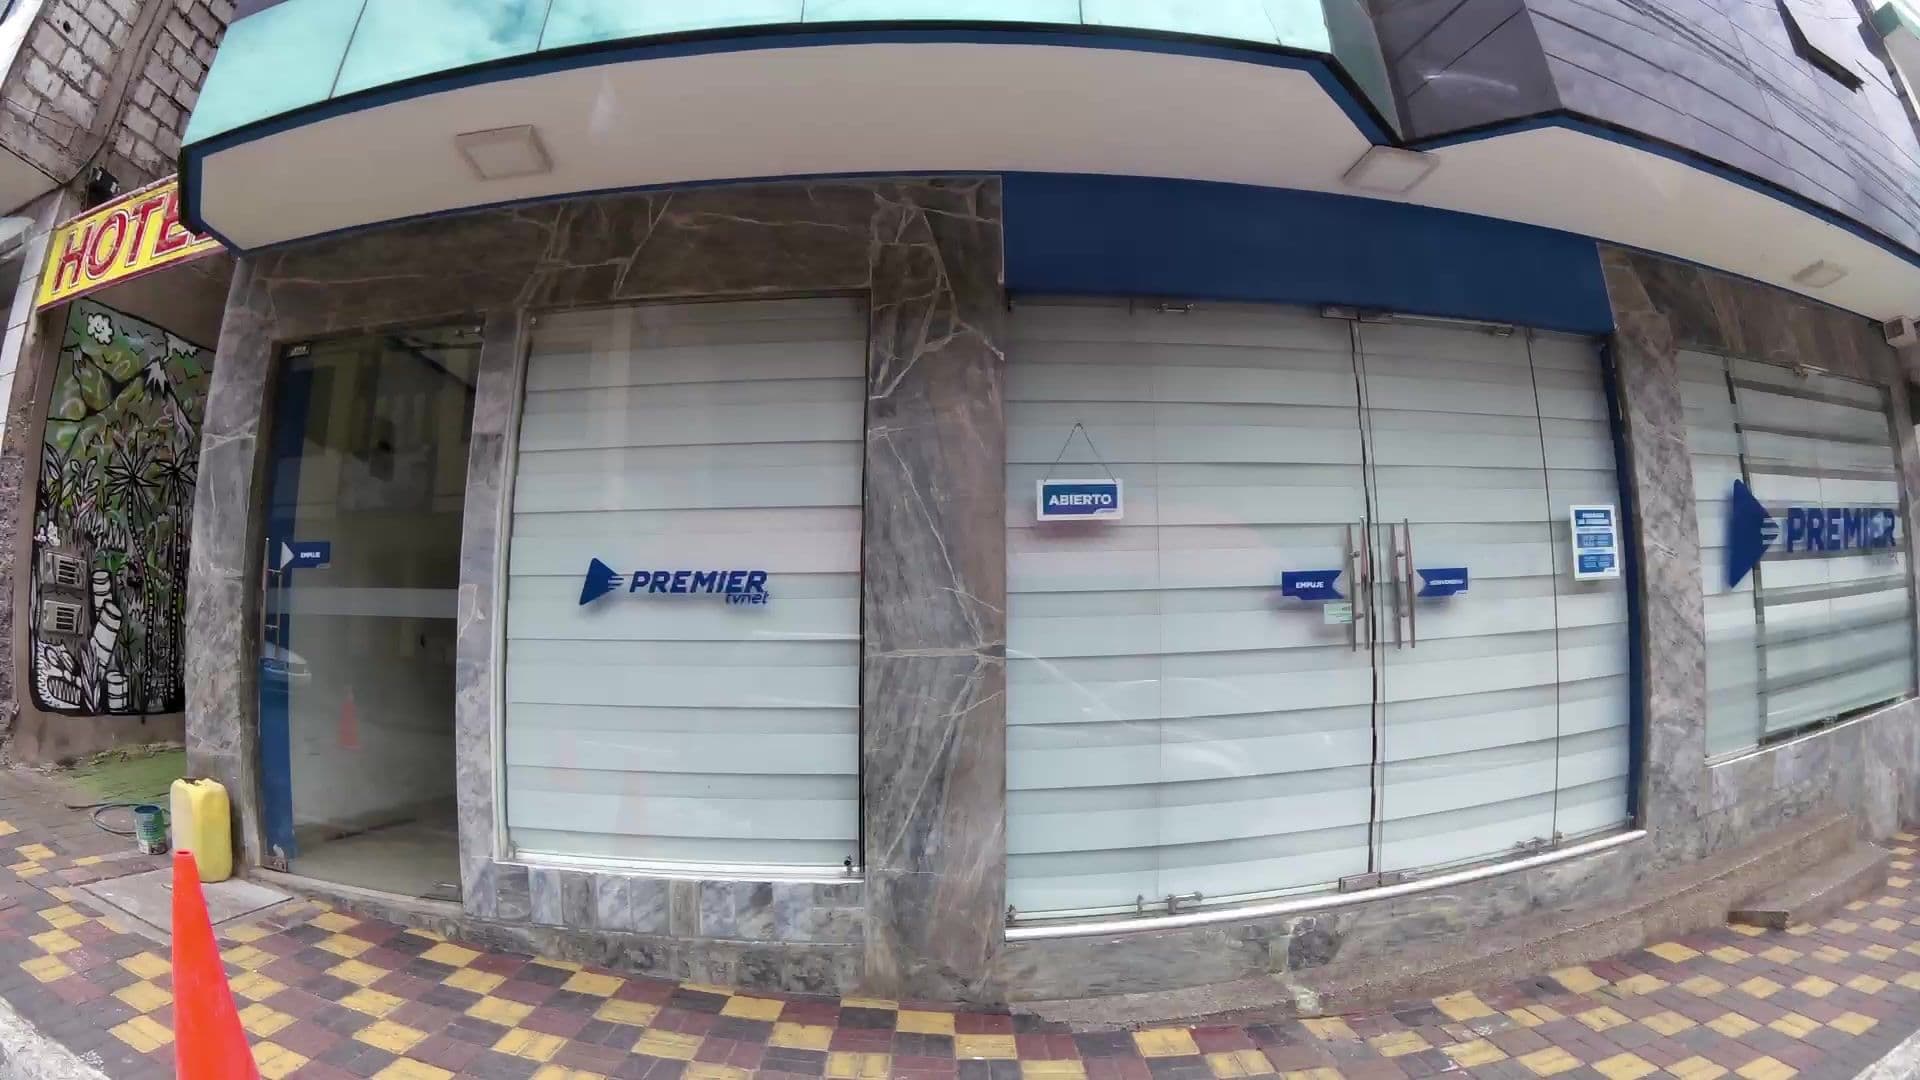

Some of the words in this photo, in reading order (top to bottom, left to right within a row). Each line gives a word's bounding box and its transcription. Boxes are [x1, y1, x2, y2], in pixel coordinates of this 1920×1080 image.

[51, 191, 213, 294] HOTE
[1049, 494, 1112, 505] ABIERTO
[1786, 507, 1896, 552] PREMIER
[629, 570, 768, 593] PREMIER
